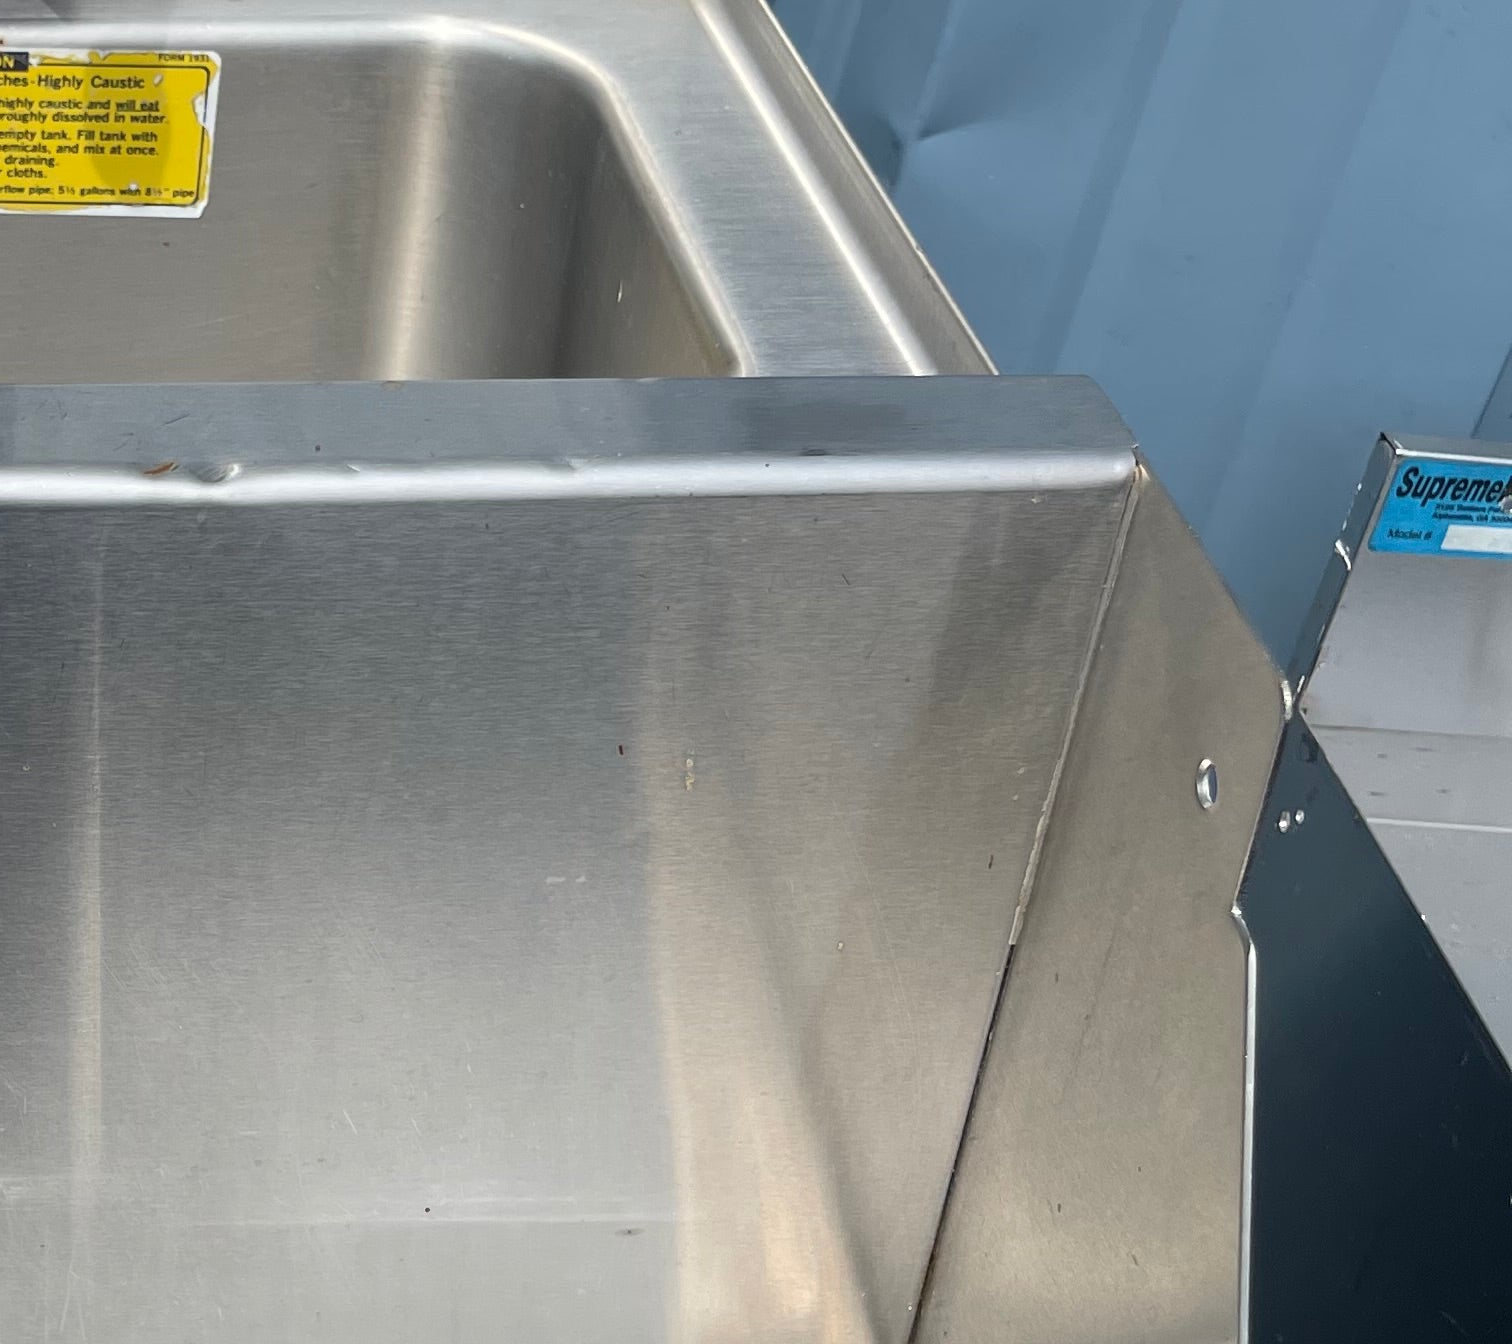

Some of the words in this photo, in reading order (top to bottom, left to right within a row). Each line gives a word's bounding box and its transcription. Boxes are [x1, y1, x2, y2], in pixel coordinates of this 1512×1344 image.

[91, 75, 145, 89] Caustic
[38, 98, 82, 110] caustic
[88, 99, 110, 110] and
[116, 100, 138, 111] will
[52, 111, 109, 123] dissolved
[114, 112, 125, 123] in
[41, 130, 71, 141] tank.
[77, 130, 95, 141] Fill
[100, 131, 127, 142] tank
[131, 132, 158, 143] with
[56, 144, 79, 154] and
[84, 145, 105, 154] mix
[110, 145, 122, 155] at
[126, 146, 159, 156] once.
[5, 155, 59, 168] draining.
[7, 167, 48, 178] cloths.
[80, 186, 115, 197] gallons
[173, 188, 195, 198] pipe
